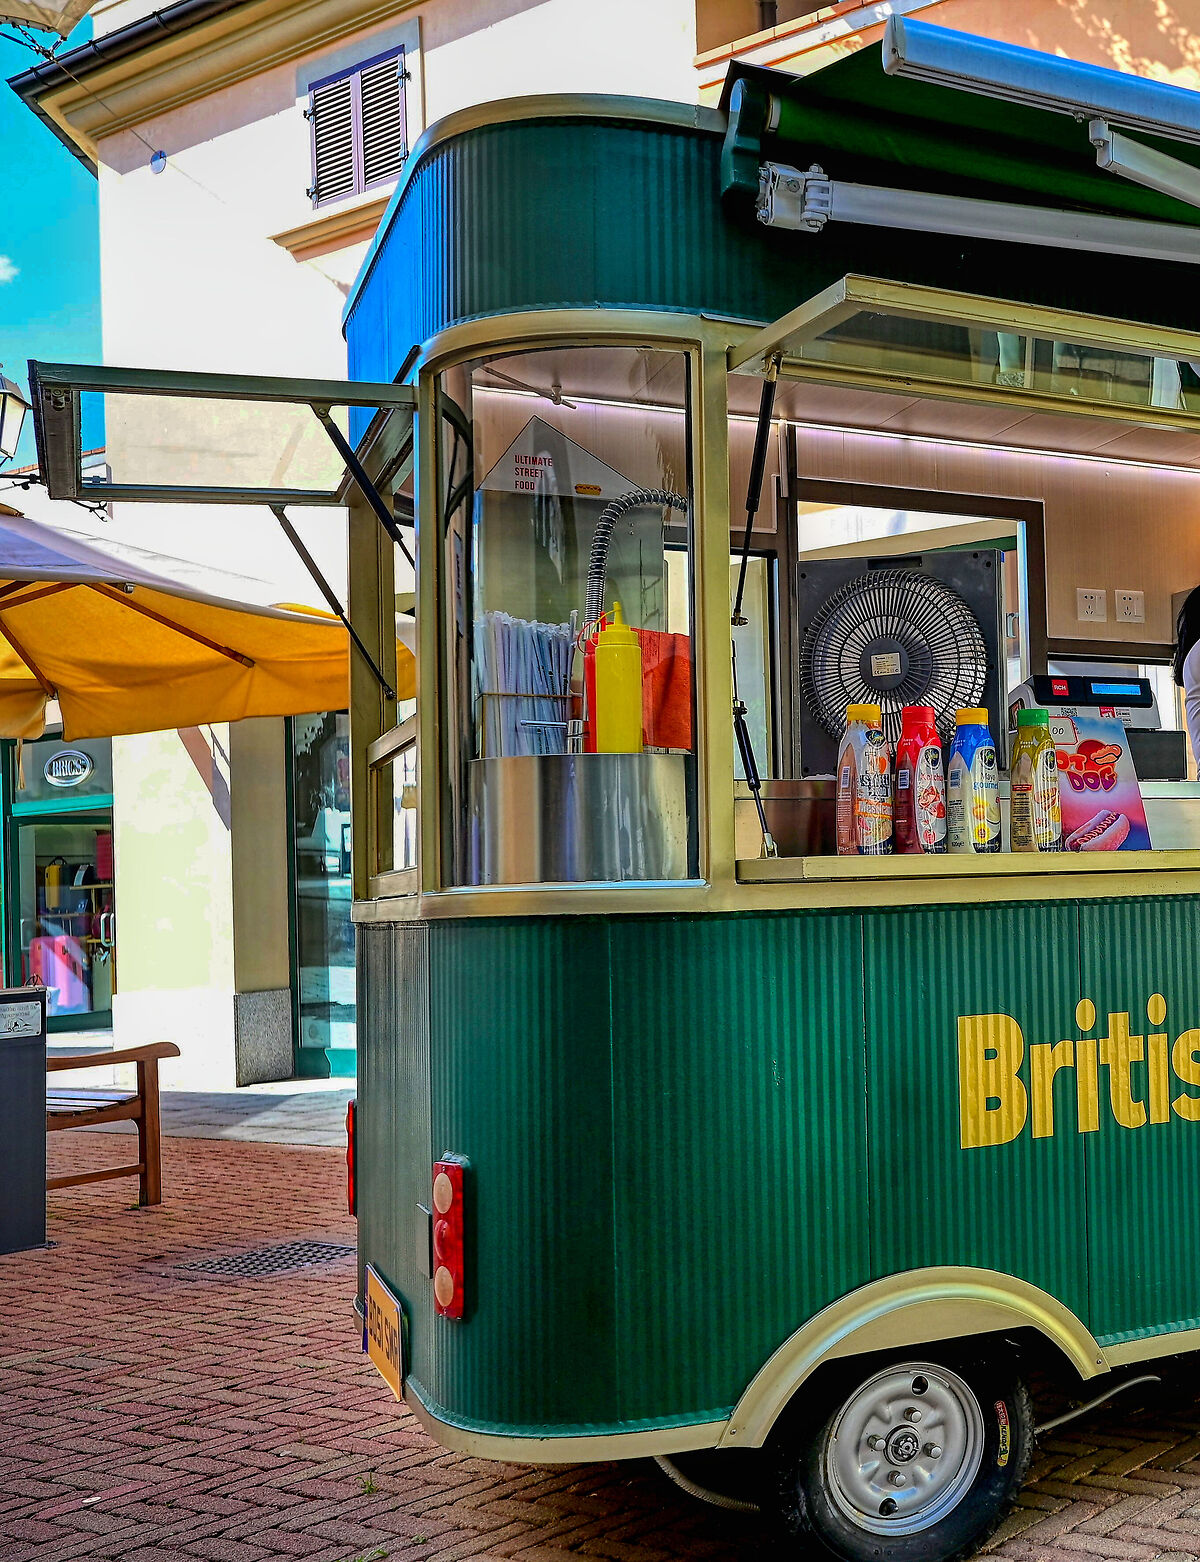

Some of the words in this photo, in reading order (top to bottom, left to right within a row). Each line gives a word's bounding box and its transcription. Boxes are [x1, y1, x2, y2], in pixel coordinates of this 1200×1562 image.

[514, 455, 553, 467] ULTIMATE
[514, 467, 544, 479] STREET
[514, 480, 535, 491] FOOD
[1055, 749, 1087, 771] OT
[1066, 765, 1118, 792] DOG
